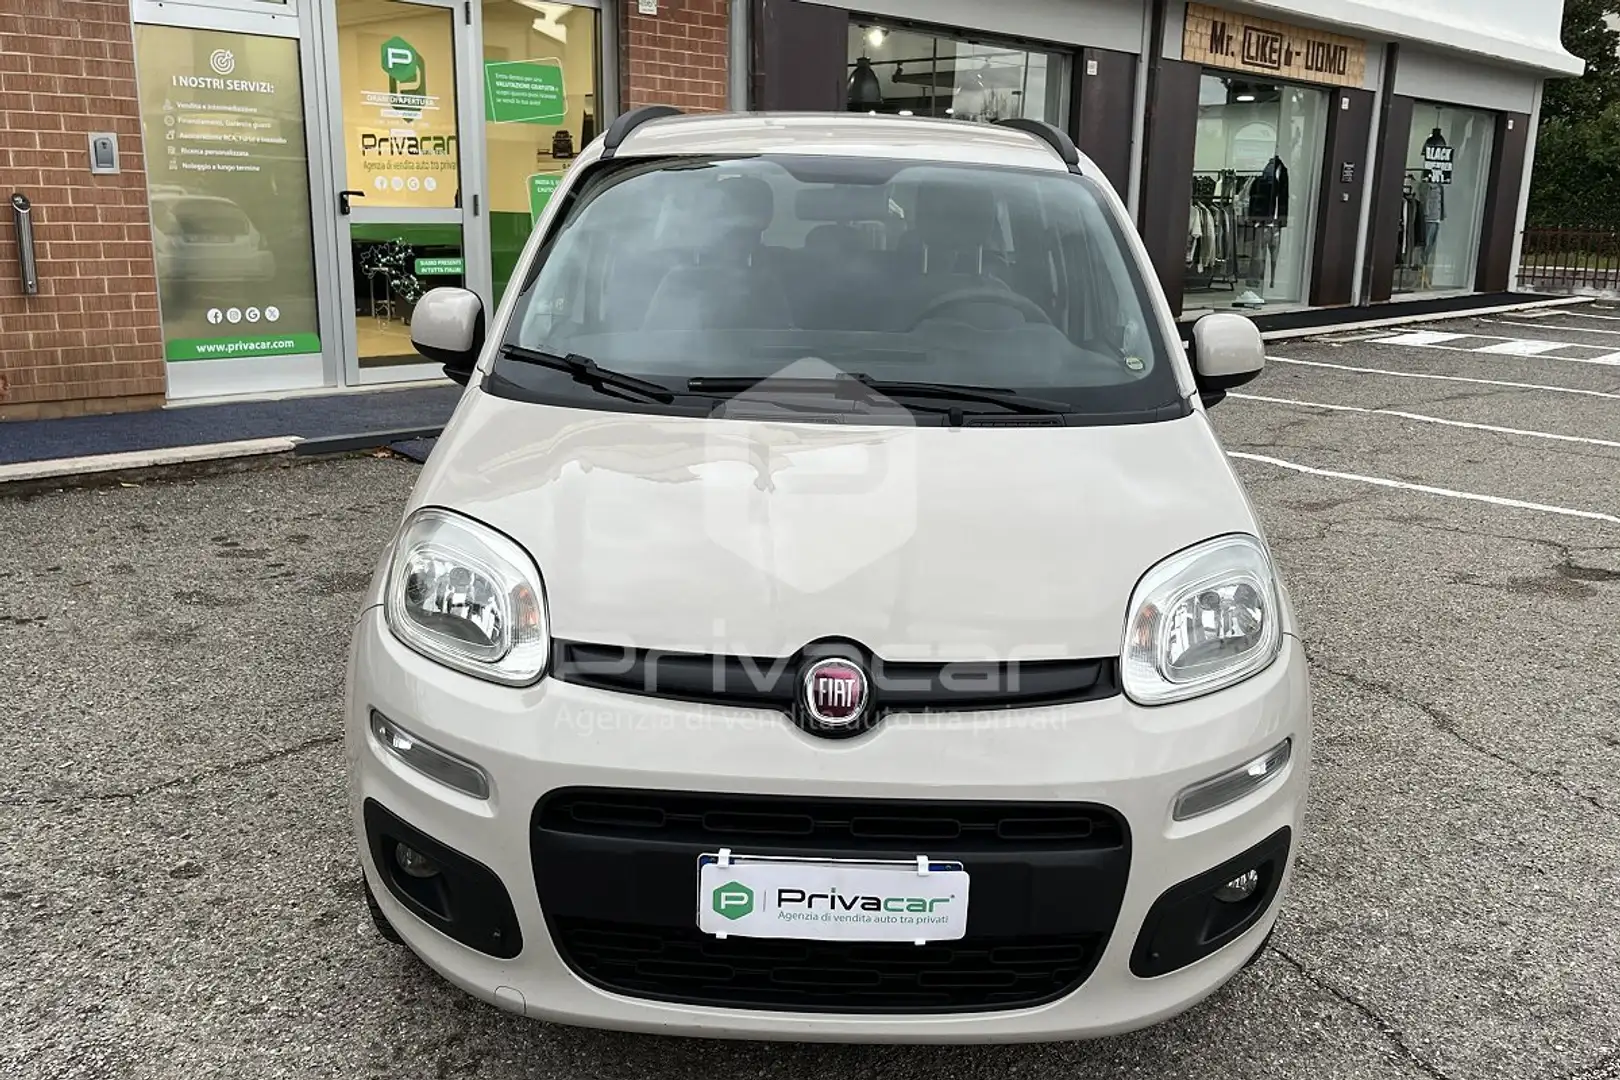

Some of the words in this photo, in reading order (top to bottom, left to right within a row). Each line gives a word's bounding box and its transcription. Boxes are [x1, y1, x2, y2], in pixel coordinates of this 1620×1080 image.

[387, 47, 413, 69] P
[1210, 20, 1235, 57] Mr.
[1246, 32, 1279, 65] LIKE
[1305, 40, 1348, 75] UOMO
[179, 76, 224, 89] NOSTRI
[227, 79, 274, 93] SERVIZI:
[361, 134, 457, 157] Privacar
[182, 162, 212, 172] Noleggio
[217, 163, 236, 172] lungo
[196, 339, 294, 354] www.privacar.com
[819, 677, 855, 708] FIAT
[720, 892, 749, 909] P
[777, 887, 950, 913] Privacar
[778, 911, 819, 923] Agenzia
[821, 912, 831, 922] di
[834, 912, 872, 924] vendita
[874, 914, 897, 924] auto
[900, 915, 914, 924] tra
[916, 914, 948, 925] privati
